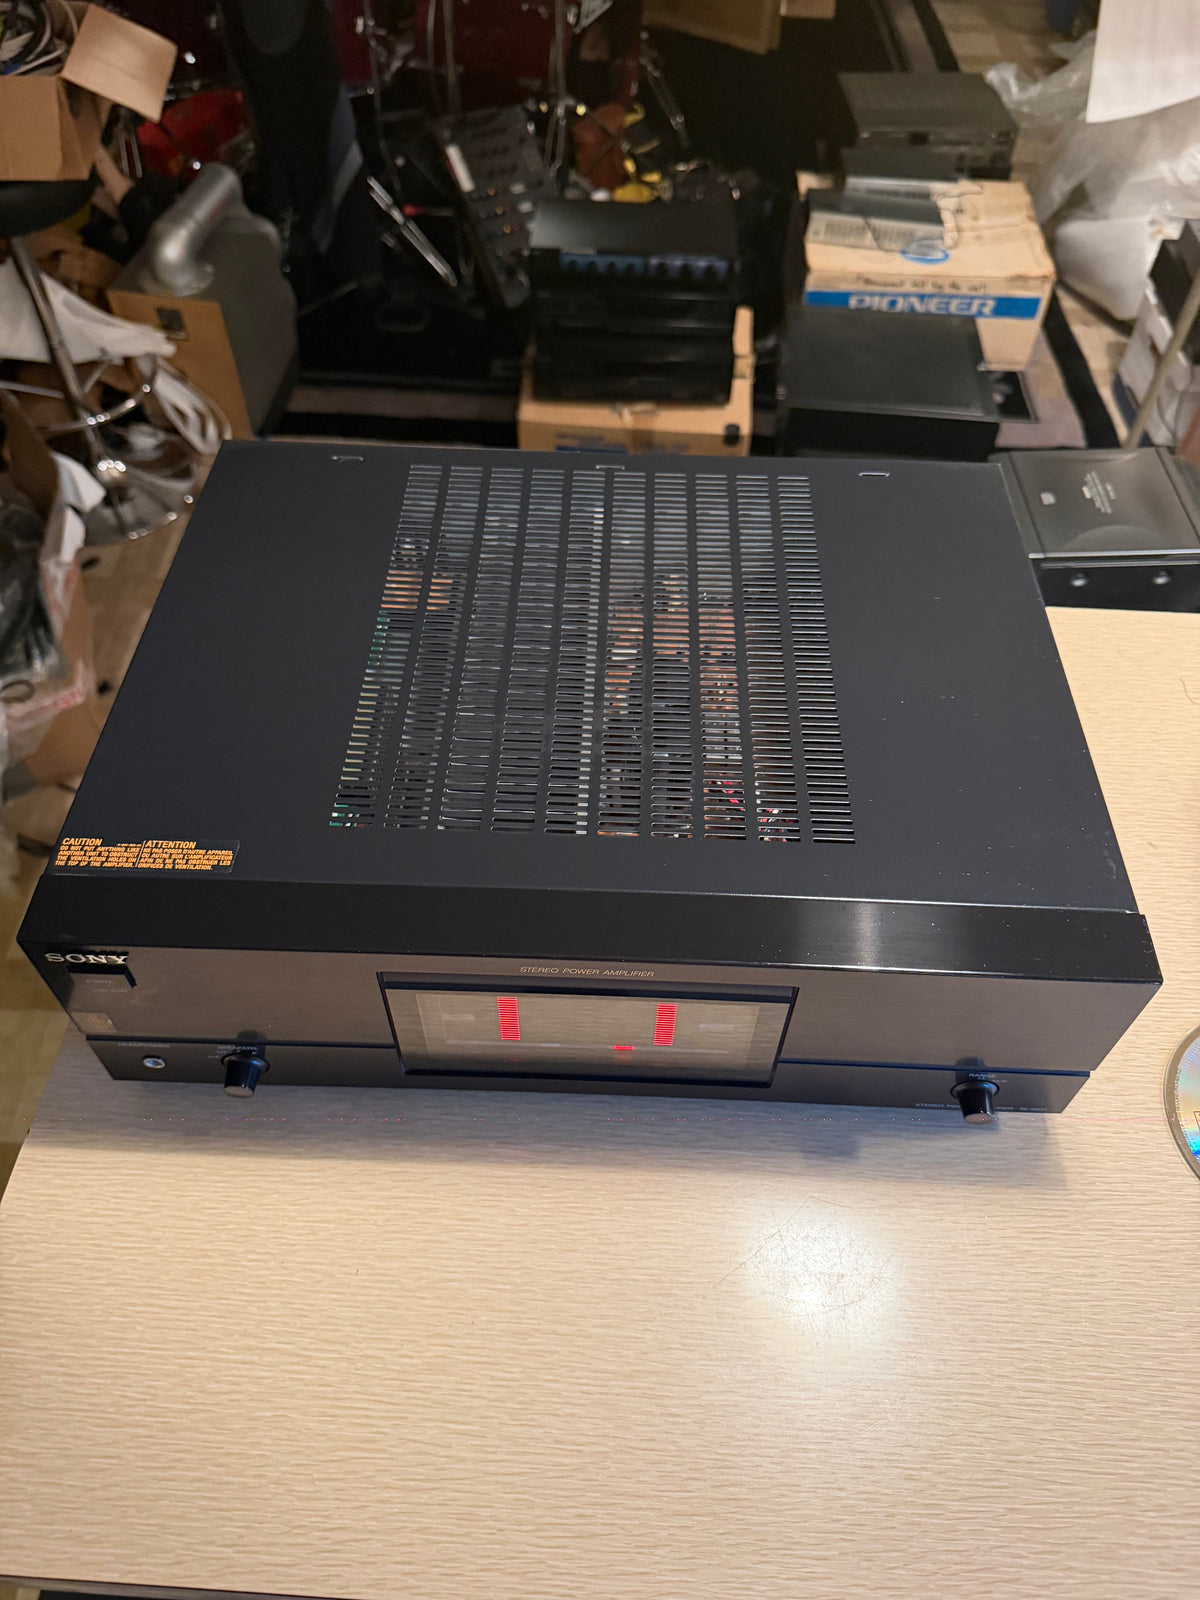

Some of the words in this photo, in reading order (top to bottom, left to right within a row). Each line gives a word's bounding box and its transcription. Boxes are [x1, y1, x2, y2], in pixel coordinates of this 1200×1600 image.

[848, 294, 997, 316] PIONEER
[62, 838, 102, 846] CAUTION
[145, 840, 196, 849] ATTENTION
[44, 952, 128, 965] SONY
[519, 966, 559, 974] STEREO
[562, 967, 600, 975] POWER
[602, 968, 656, 977] AMPLIFIER
